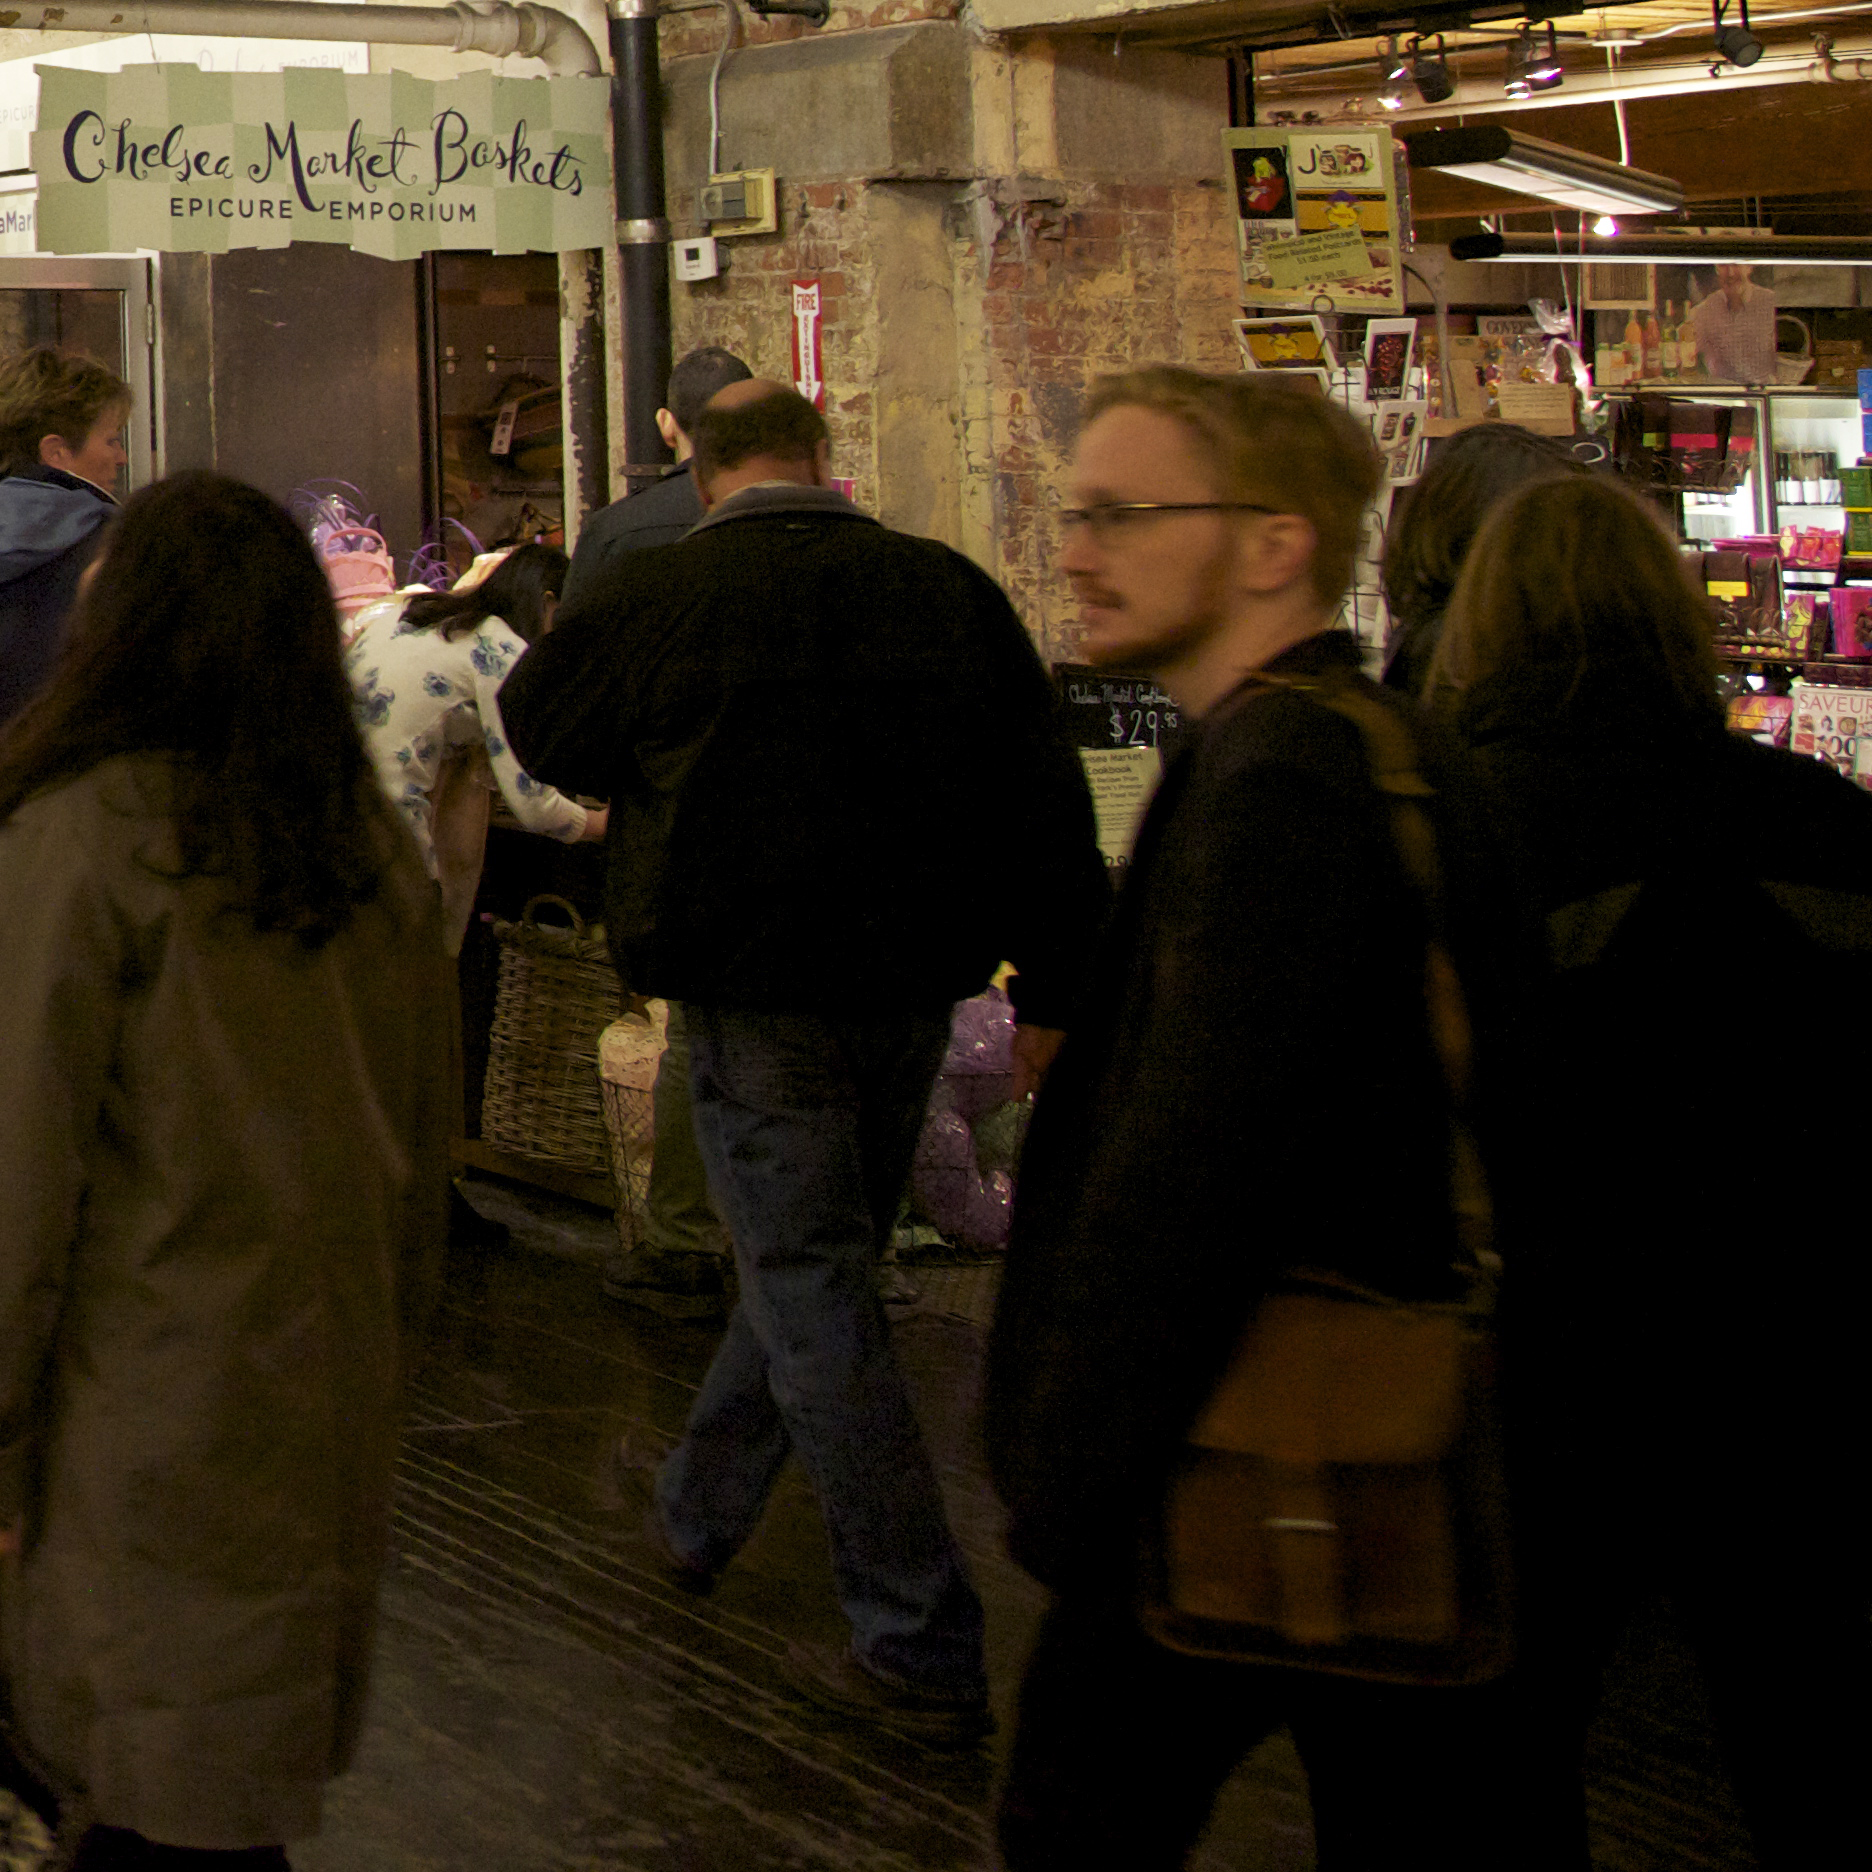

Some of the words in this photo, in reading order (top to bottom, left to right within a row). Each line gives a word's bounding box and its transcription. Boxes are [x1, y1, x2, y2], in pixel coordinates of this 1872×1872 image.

[62, 108, 235, 186] Chelsea
[247, 116, 417, 213] Market
[417, 106, 585, 197] Baskets
[169, 196, 294, 220] EPICURE
[329, 198, 477, 224] EMPORIUM
[796, 293, 816, 310] FIRE
[802, 314, 812, 401] EXTINGUISHE
